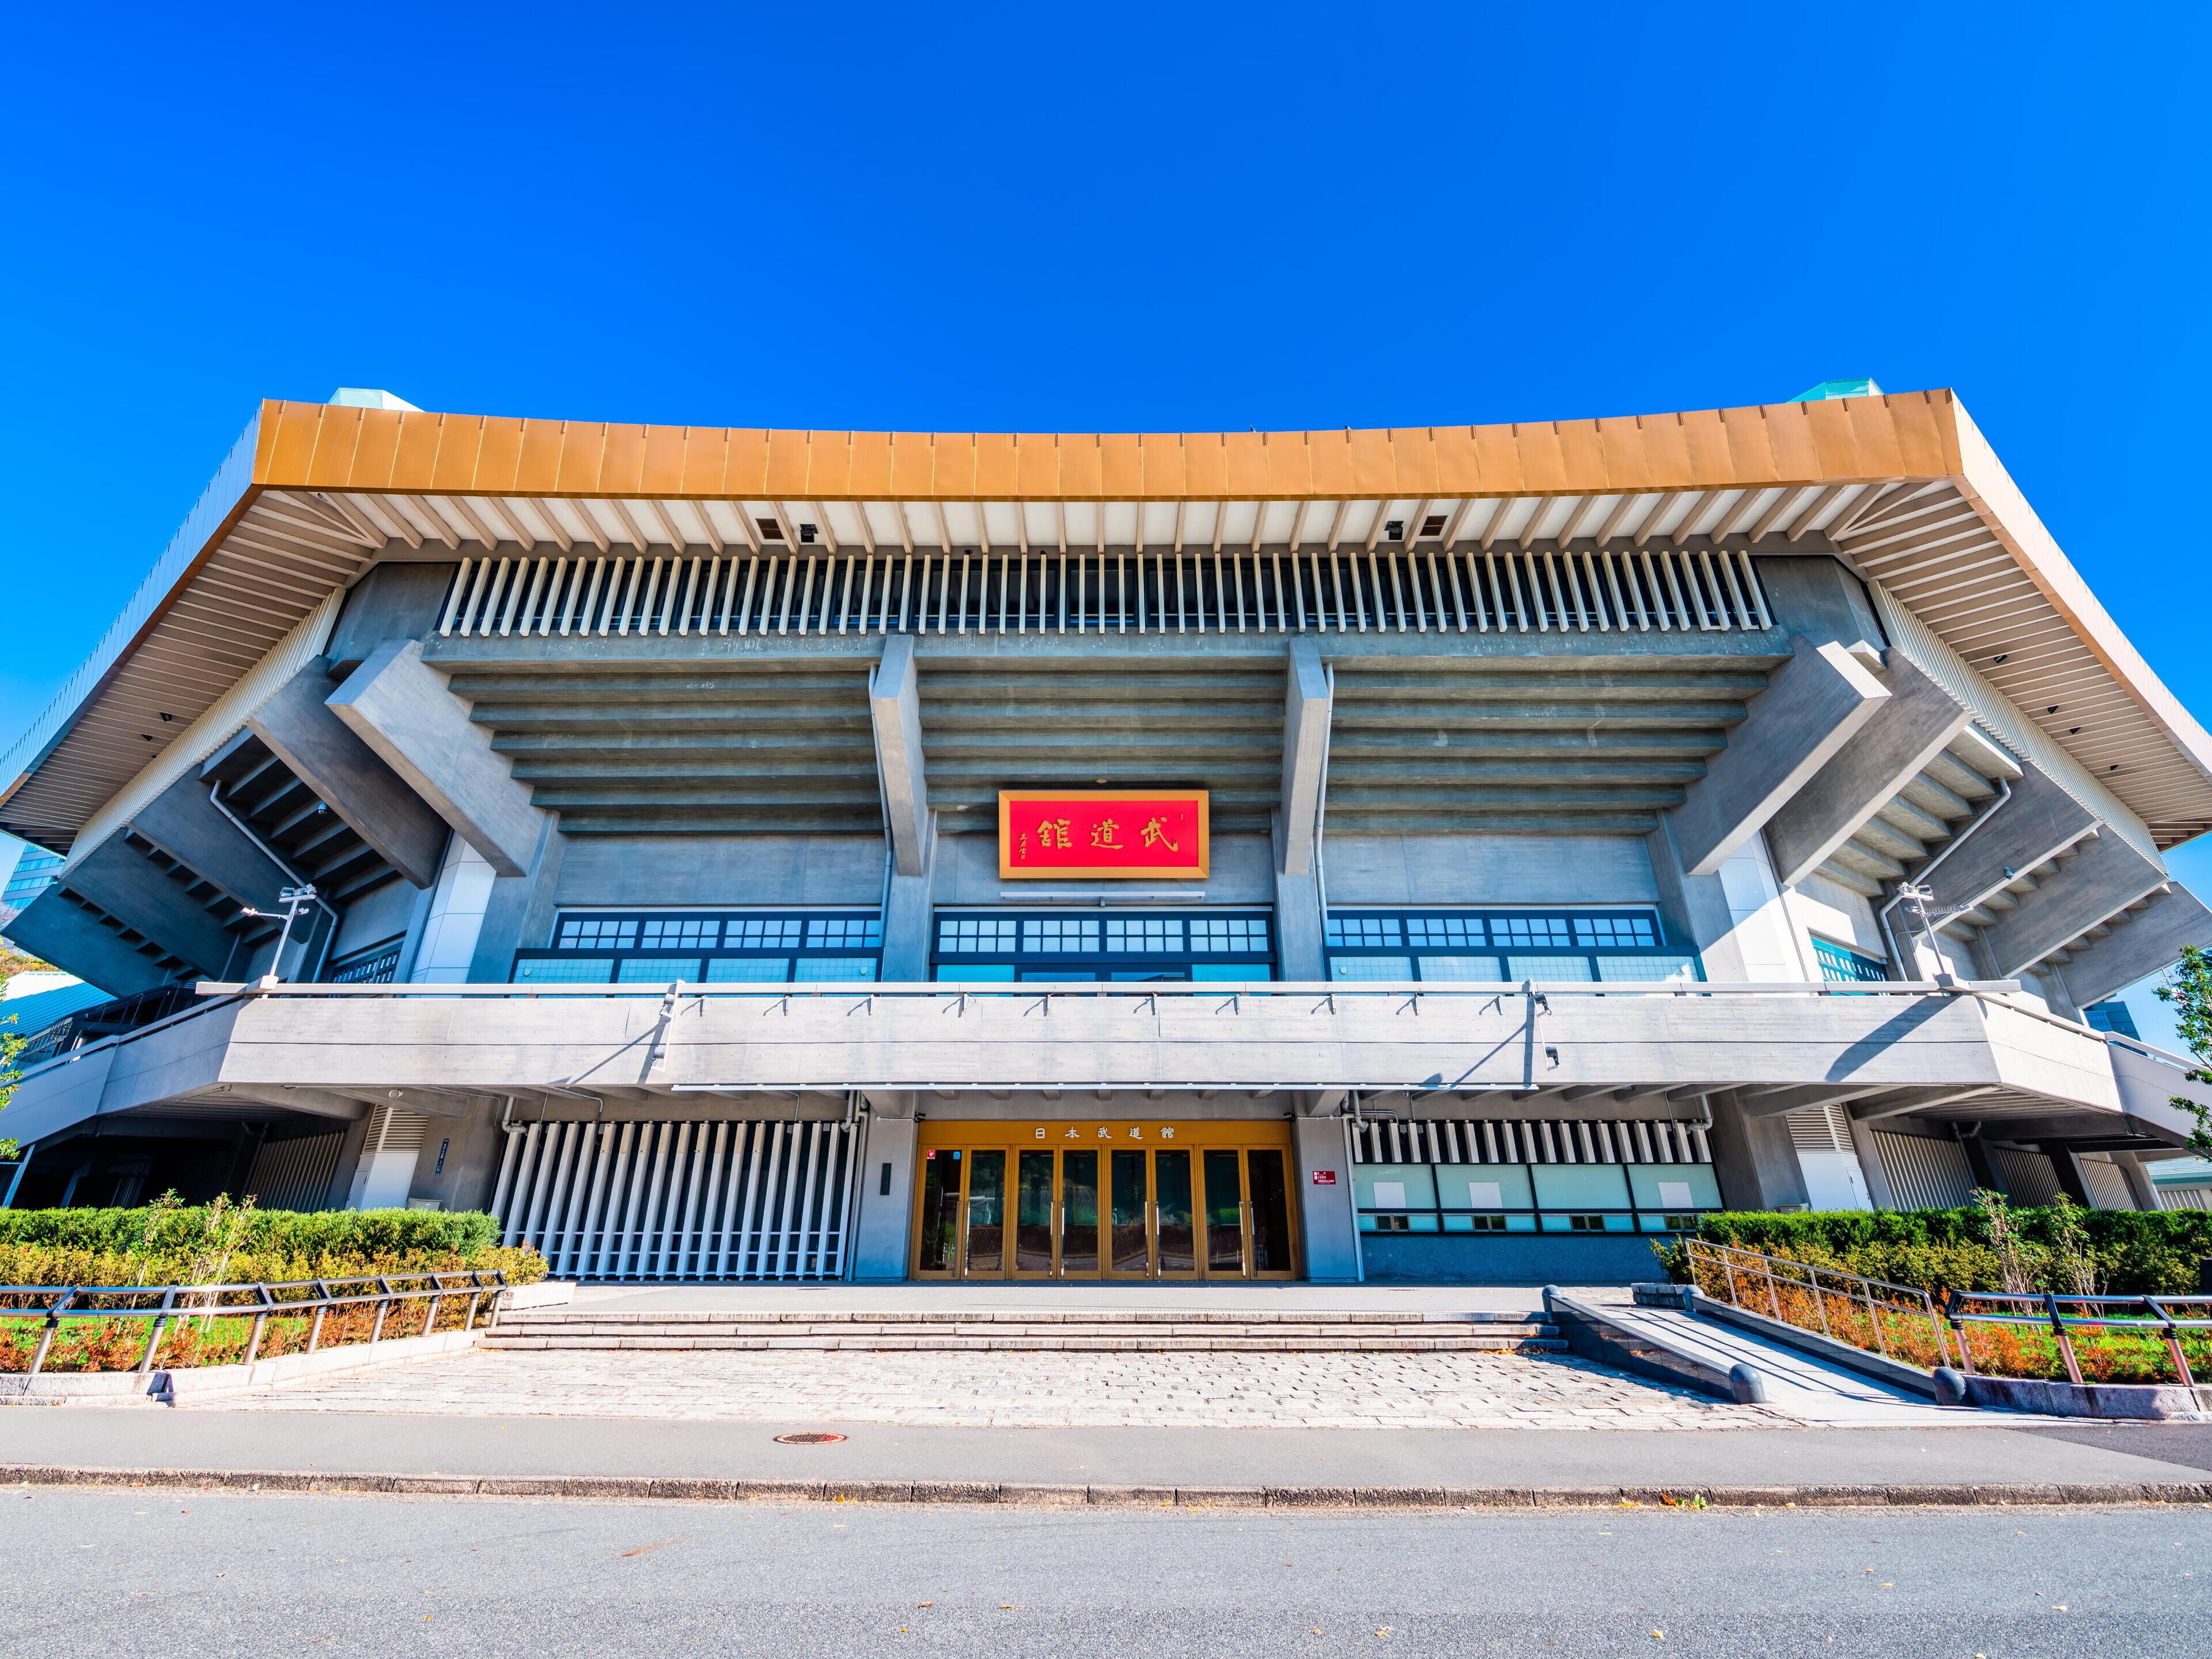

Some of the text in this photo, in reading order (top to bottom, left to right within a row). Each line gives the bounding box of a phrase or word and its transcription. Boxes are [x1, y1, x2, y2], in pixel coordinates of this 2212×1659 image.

[1035, 1126, 1175, 1140] 日本武道館
